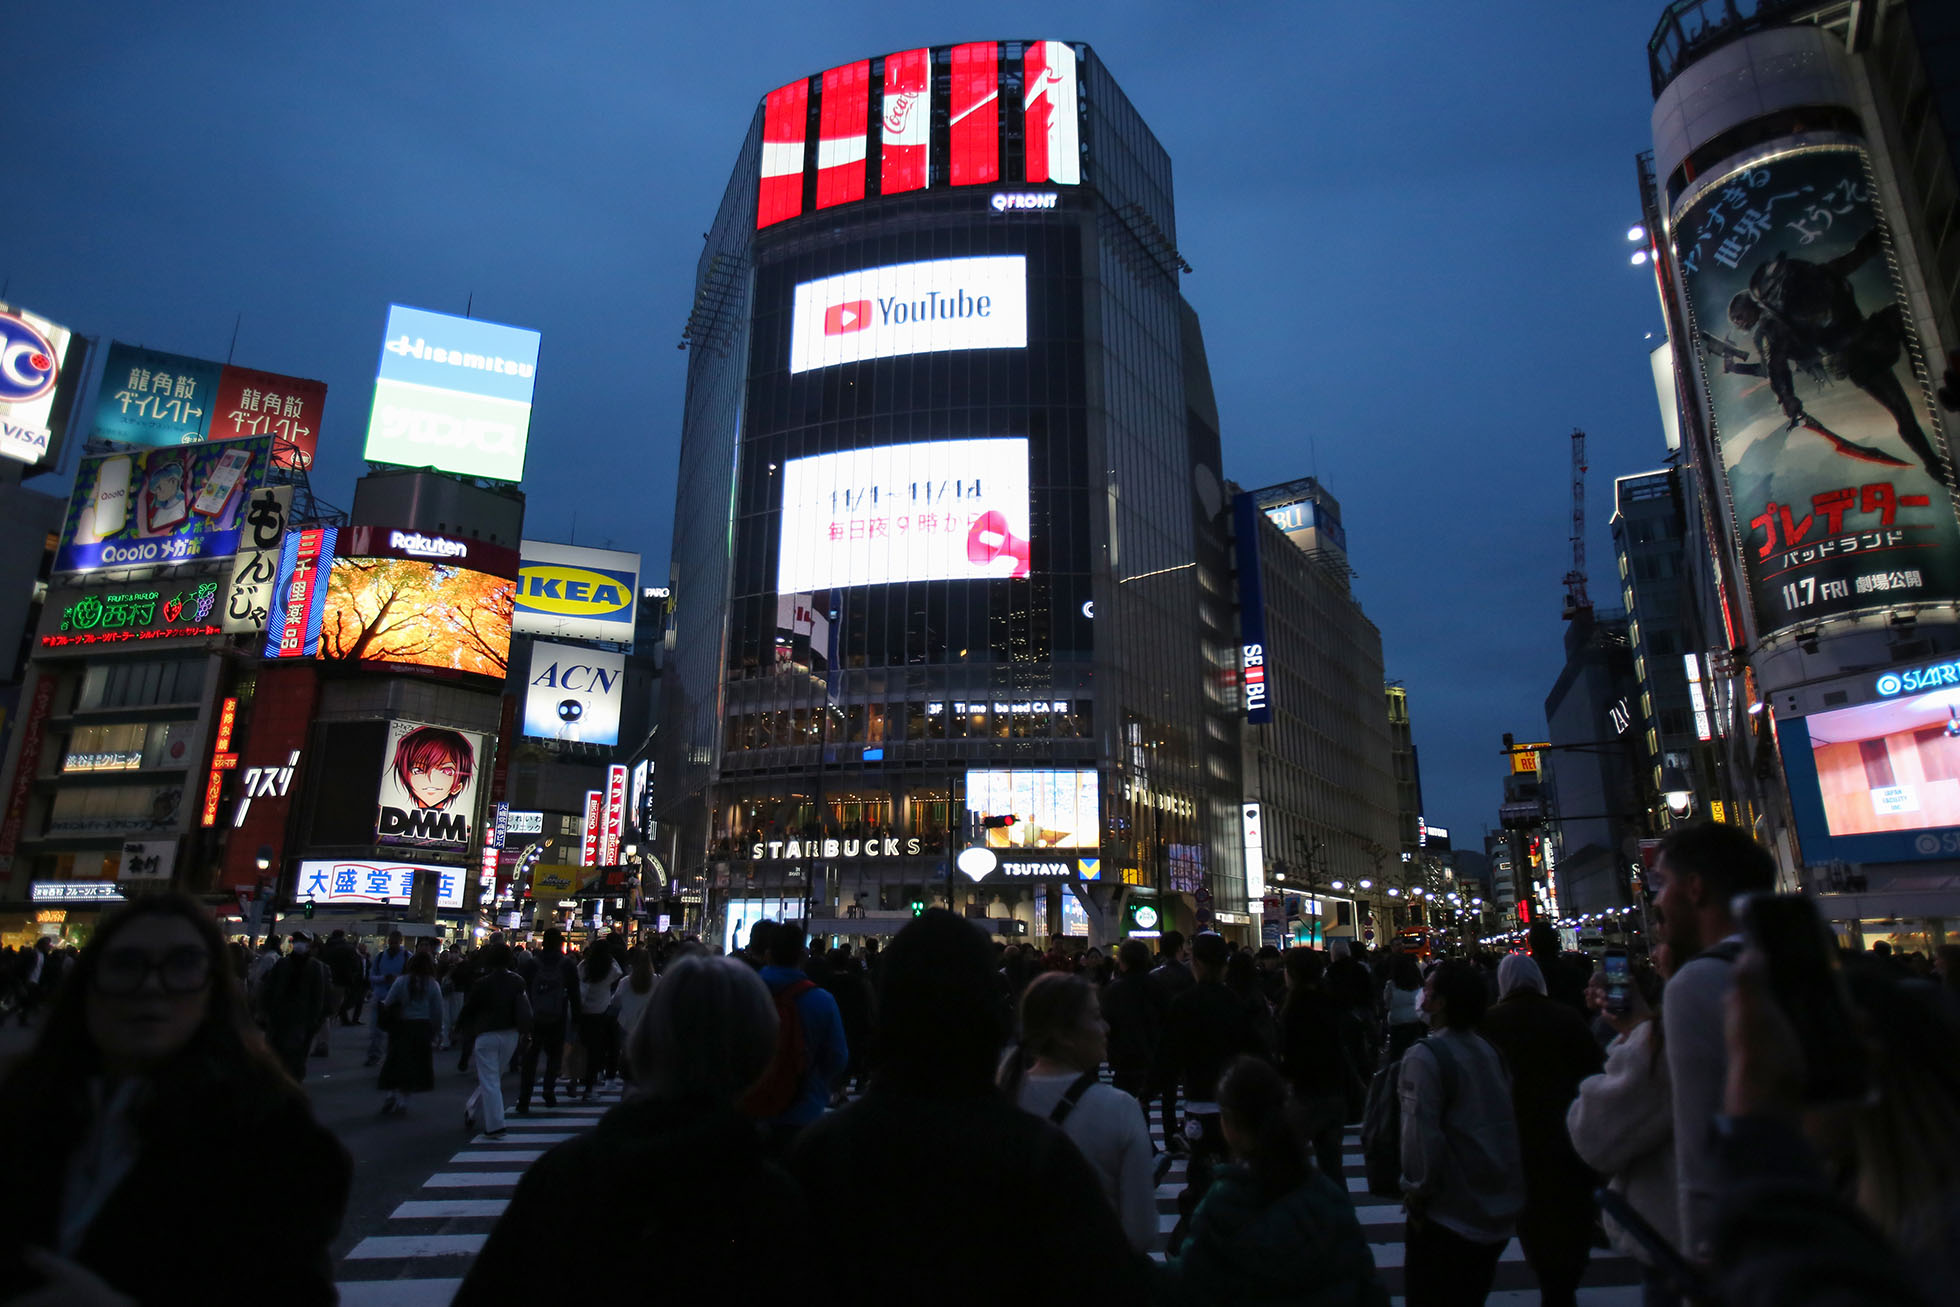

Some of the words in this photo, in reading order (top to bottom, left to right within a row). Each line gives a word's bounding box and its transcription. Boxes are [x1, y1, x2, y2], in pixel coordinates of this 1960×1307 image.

[992, 194, 1057, 212] QFRONT
[878, 289, 991, 326] YouTube
[387, 335, 534, 378] Hisamitsu
[128, 367, 197, 400] 龍角散
[114, 391, 204, 424] ダイレクト
[240, 387, 304, 419] 龍角散
[3, 422, 46, 448] VISA
[1751, 482, 1929, 557] プレデター
[102, 540, 157, 563] Qoo10
[230, 490, 284, 629] もんじゃ
[391, 531, 458, 557] Rakuten
[1783, 531, 1903, 568] バッドランド
[281, 534, 316, 649] 三千里薬品
[517, 575, 622, 607] IKEA
[1783, 577, 1816, 611] 11.7
[1820, 580, 1849, 601] FRI
[1856, 570, 1922, 594] 劇場公開
[102, 602, 156, 628] 西村
[531, 662, 622, 694] ACN
[1243, 644, 1267, 712] SEIBU
[929, 703, 943, 714] 3F
[609, 774, 623, 828] カラオケ
[380, 806, 467, 843] DMM
[753, 839, 922, 859] STARBUCKS
[1003, 863, 1070, 875] TSUTAYA
